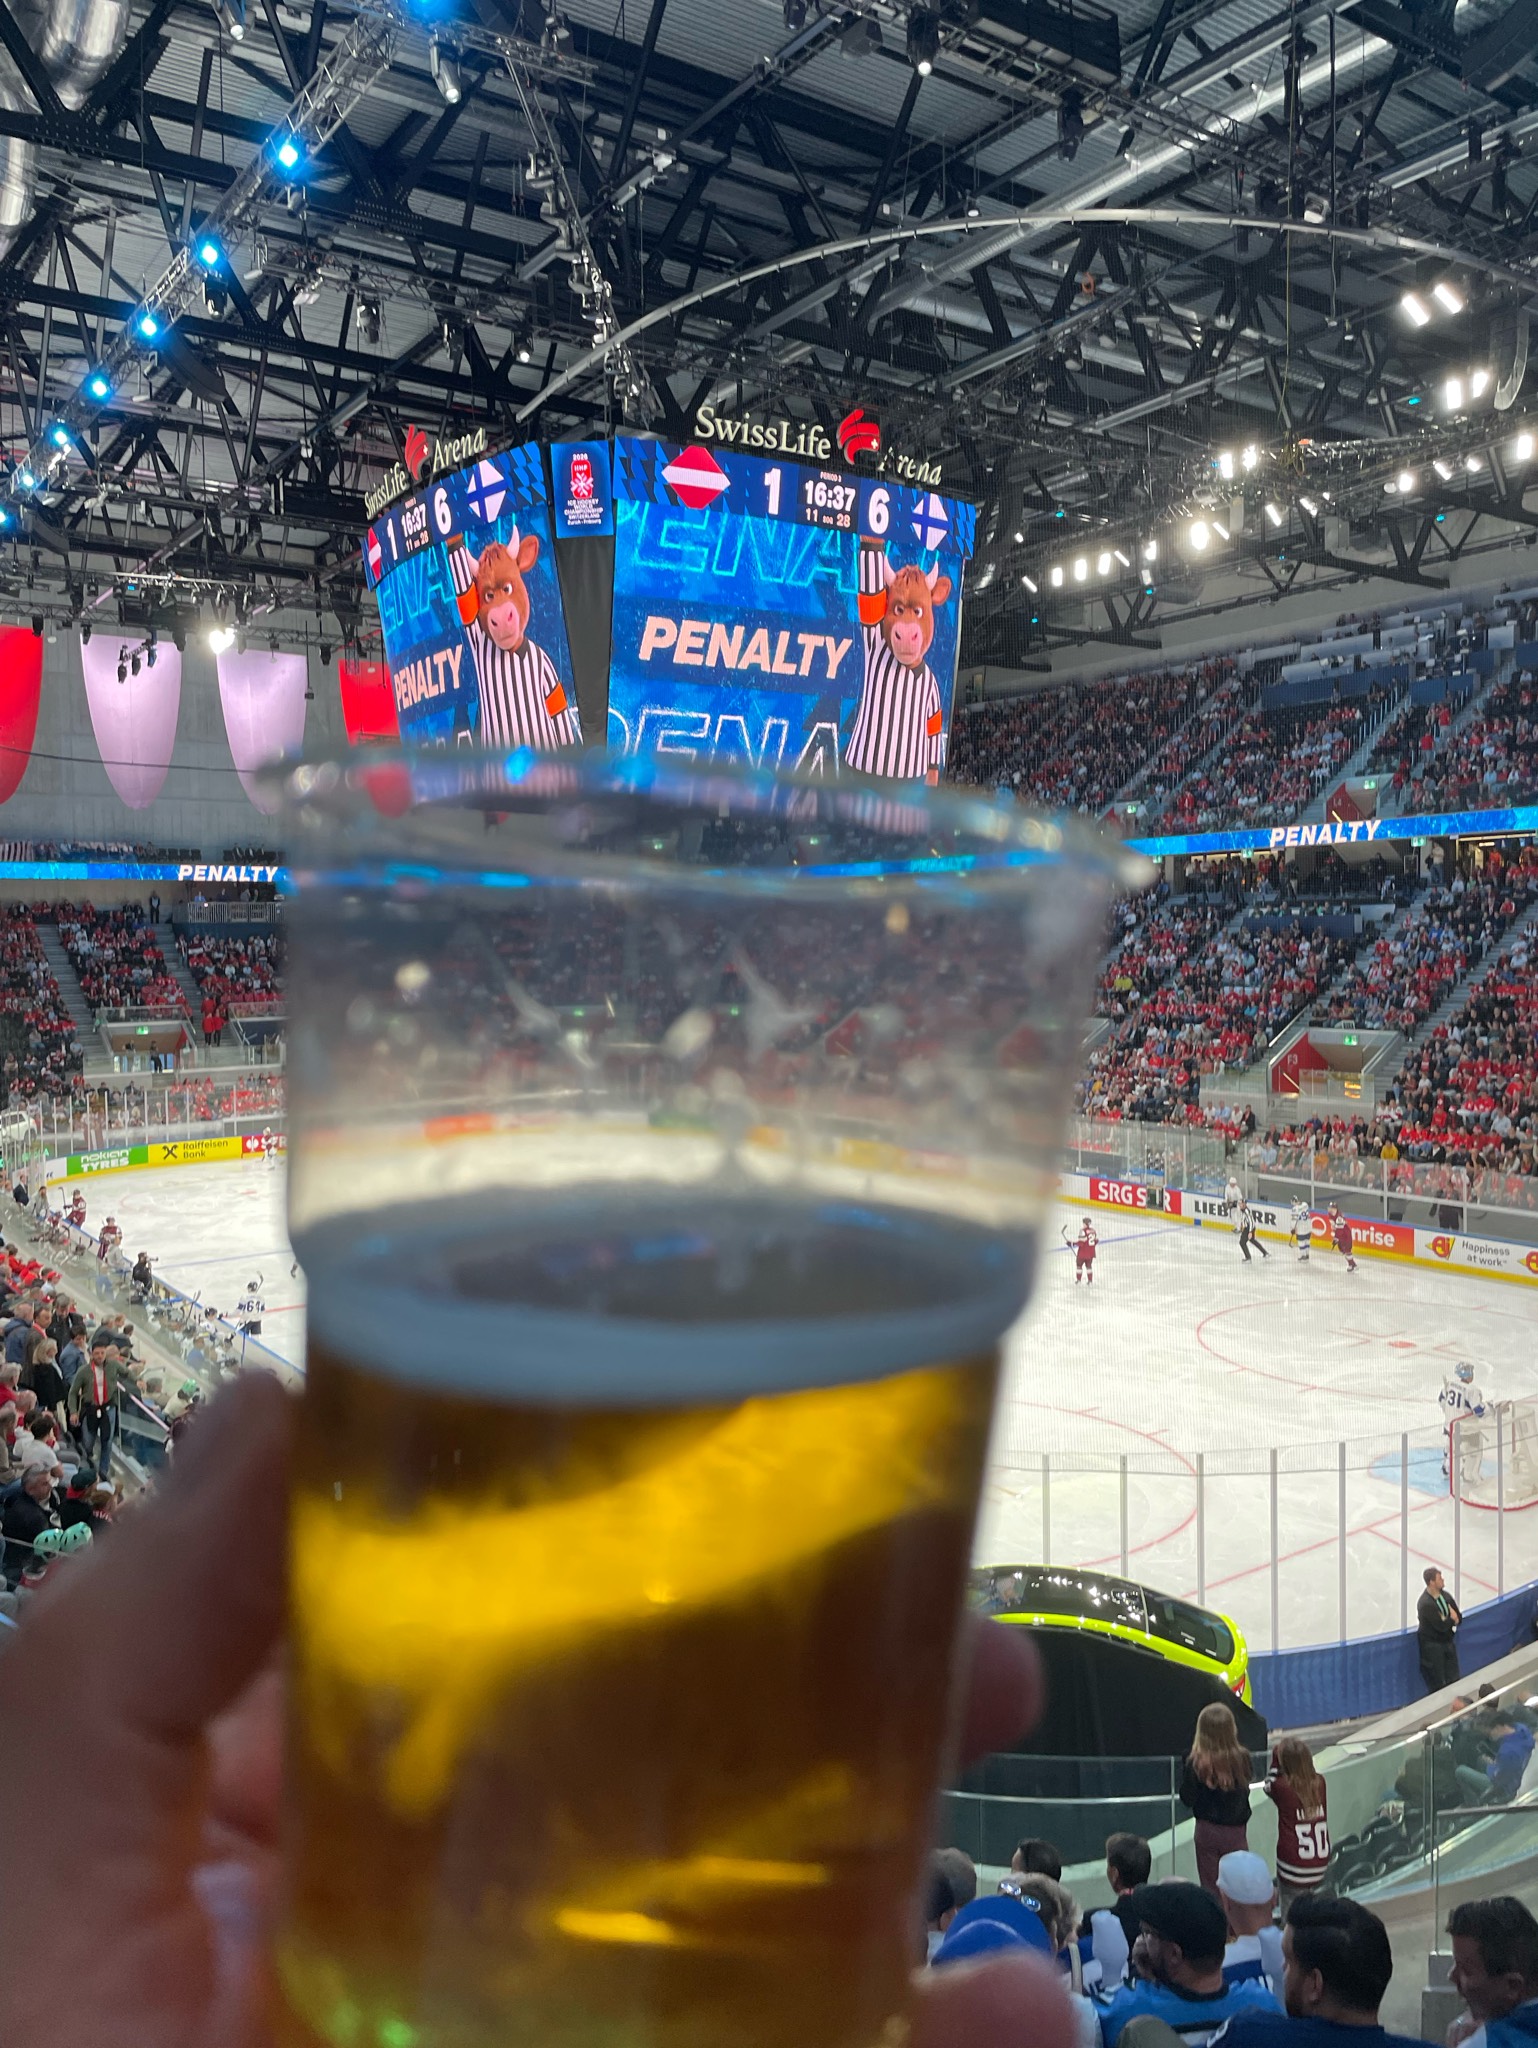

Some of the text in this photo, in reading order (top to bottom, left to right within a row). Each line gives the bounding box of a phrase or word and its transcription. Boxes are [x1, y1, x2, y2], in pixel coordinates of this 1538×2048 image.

[694, 406, 832, 460] SwissLife
[364, 427, 486, 520] SwissLife Arena
[764, 468, 781, 516] 1
[805, 479, 856, 512] 16:37
[401, 503, 427, 537] 16:37
[434, 487, 452, 535] 6
[805, 508, 818, 522] 11
[836, 513, 851, 528] 28
[868, 487, 891, 536] 6
[387, 518, 398, 561] 1
[638, 616, 853, 680] PENALTY
[394, 644, 463, 712] PENALTY
[1270, 820, 1381, 848] PENALTY
[178, 864, 278, 882] PENALTY
[1287, 1054, 1298, 1066] F3
[183, 1139, 229, 1151] Raiffeisen
[183, 1150, 206, 1160] Bank
[81, 1156, 129, 1173] TYRES
[1098, 1181, 1172, 1212] SRG SR
[1194, 1200, 1277, 1226] LIEBRR
[1462, 1240, 1510, 1256] Happiness
[1467, 1254, 1476, 1263] at
[1447, 1390, 1462, 1409] 31
[1294, 1821, 1329, 1860] 50
